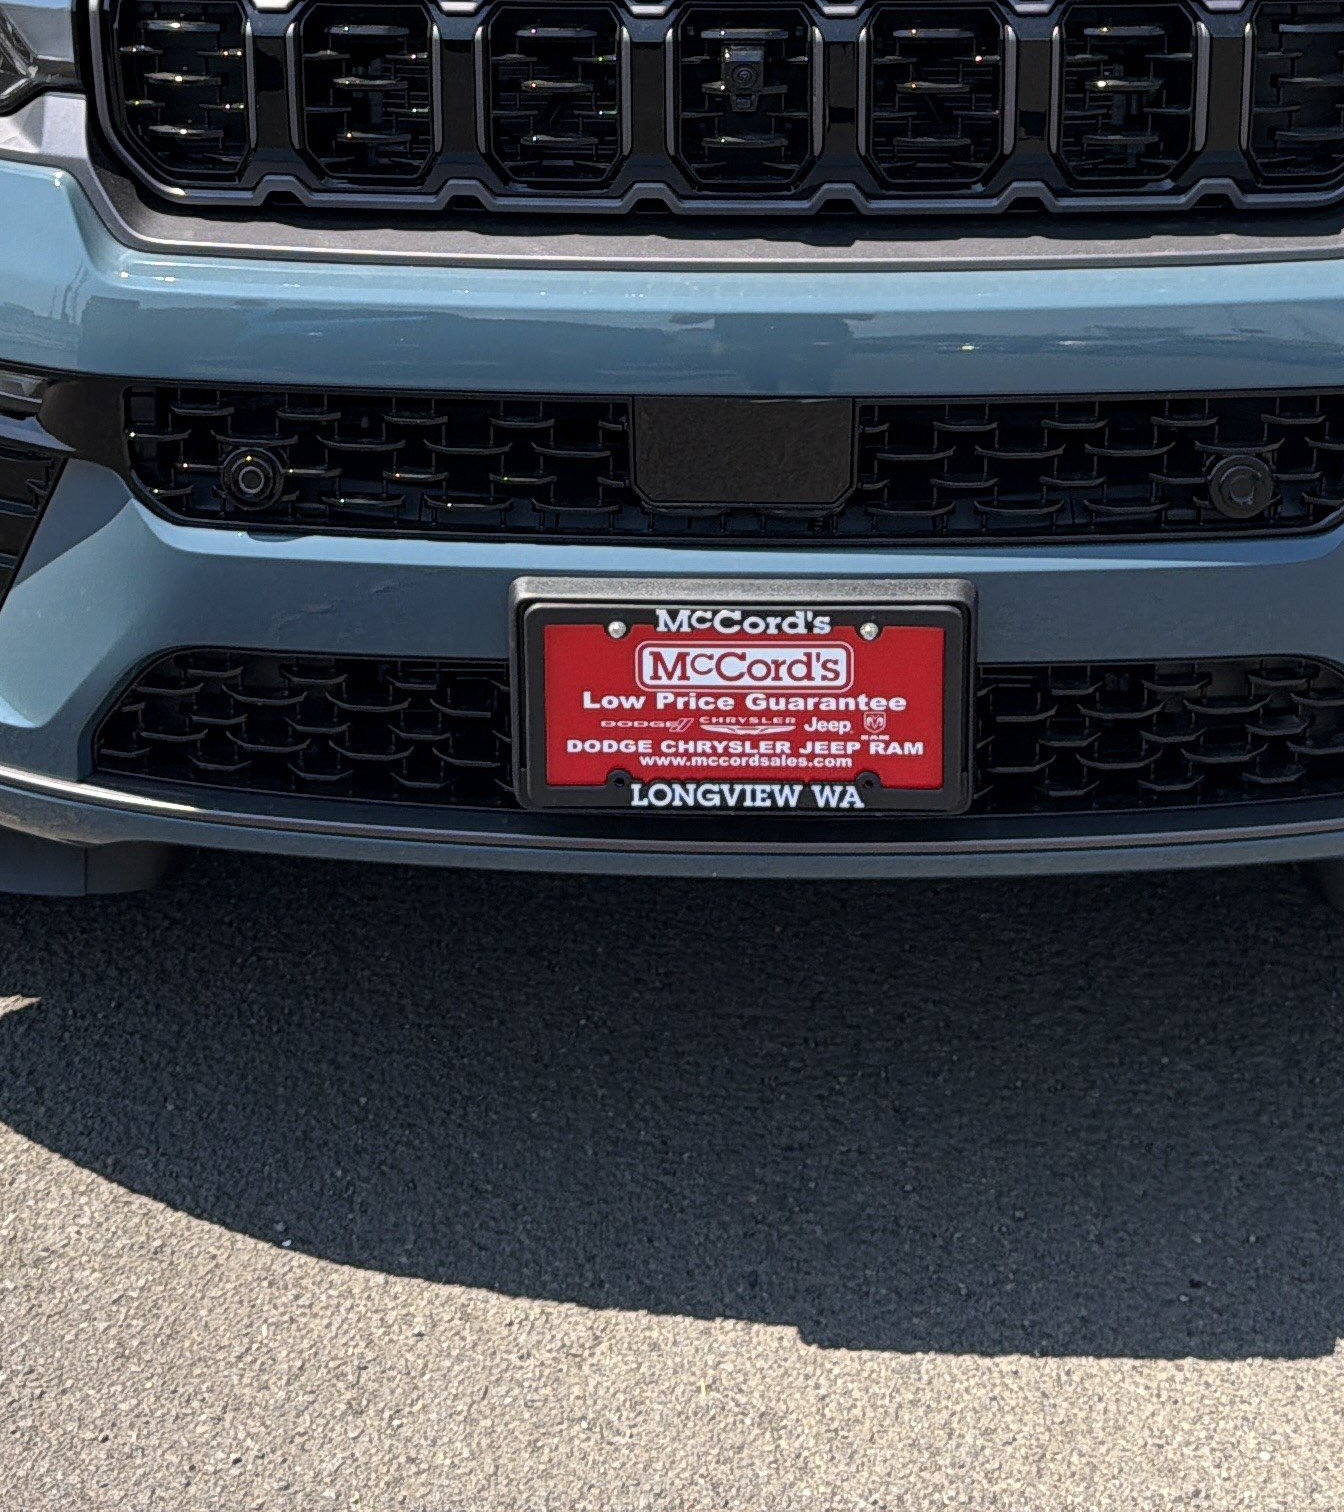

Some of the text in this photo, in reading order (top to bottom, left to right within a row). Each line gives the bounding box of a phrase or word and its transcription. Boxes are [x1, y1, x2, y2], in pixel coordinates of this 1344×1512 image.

[656, 609, 831, 634] McCord's
[649, 651, 841, 681] McCord's
[583, 691, 907, 711] Low Price Guarantee
[699, 716, 796, 724] CHRYSLER
[804, 716, 852, 735] Jeep
[567, 740, 924, 755] DODGE CHRYSLER JEEP RAM
[640, 755, 853, 768] www.mccordsales.com
[631, 783, 865, 808] LONGVIEW WA
